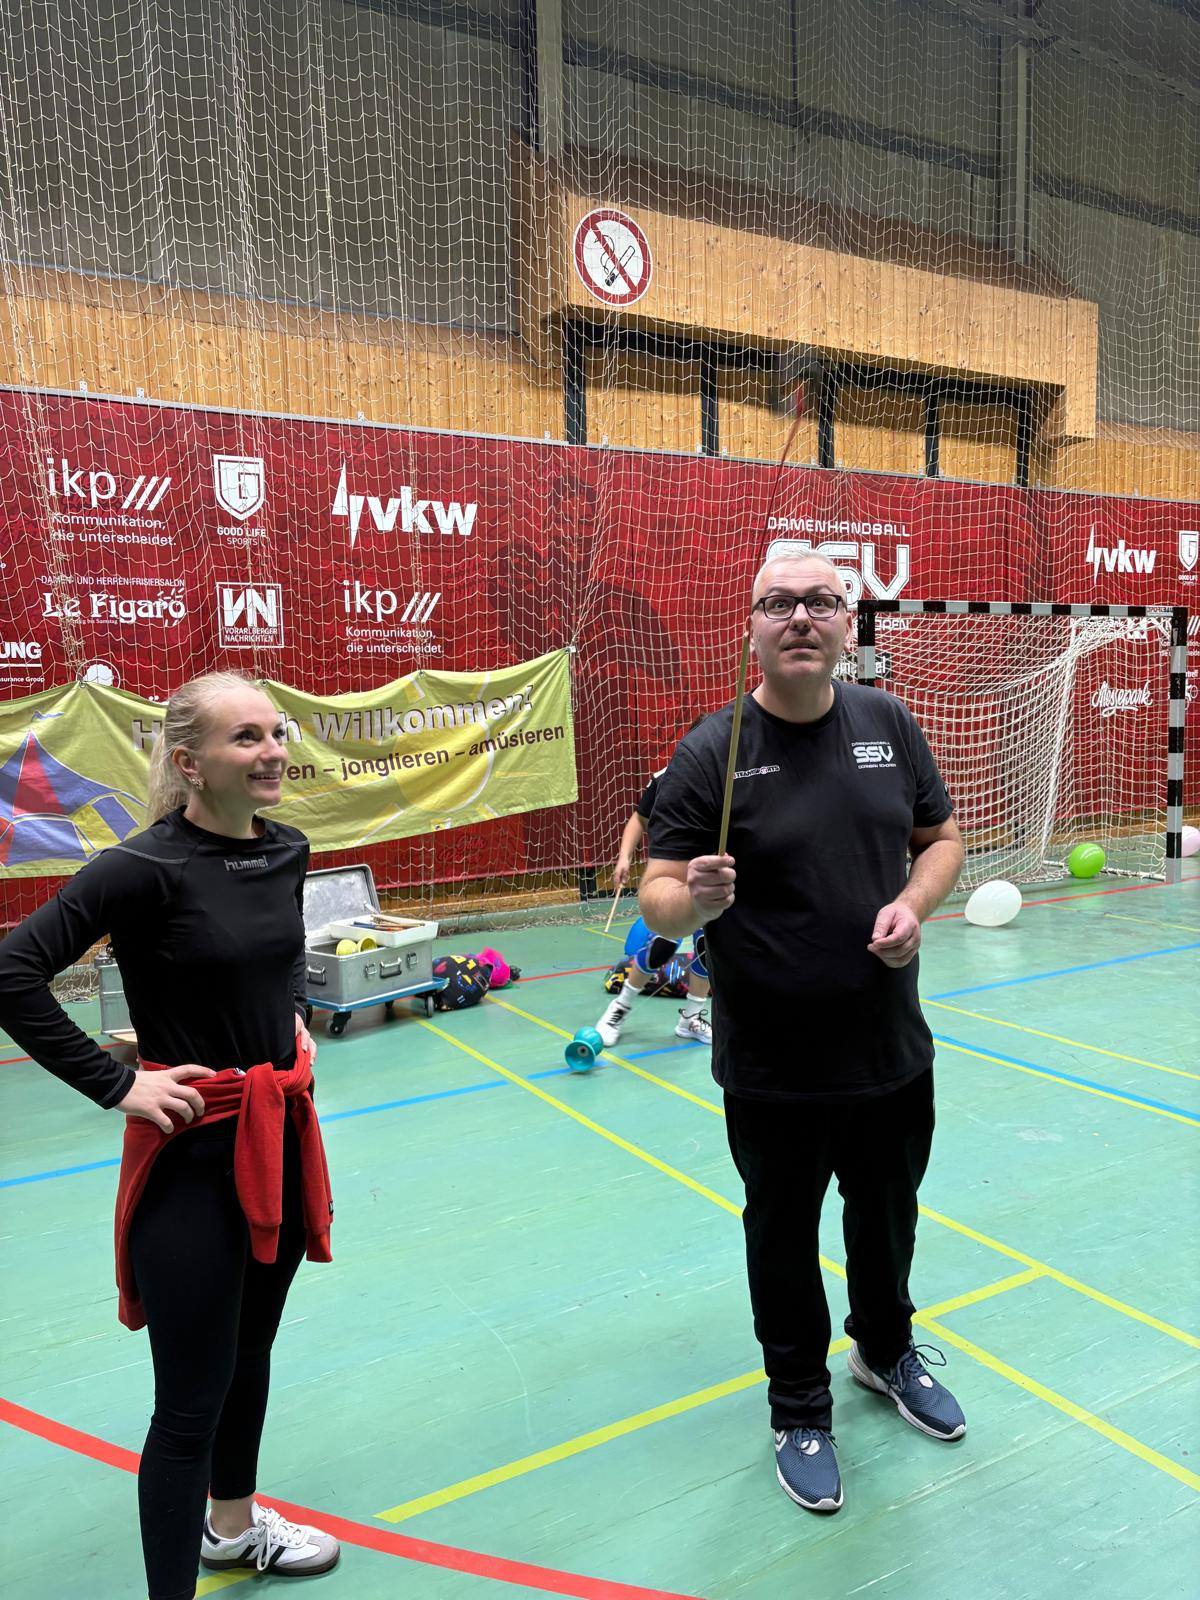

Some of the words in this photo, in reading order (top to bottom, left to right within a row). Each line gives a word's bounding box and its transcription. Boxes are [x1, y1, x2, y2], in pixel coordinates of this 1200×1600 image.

[366, 485, 478, 536] vkw
[217, 526, 244, 536] GOOD
[767, 516, 910, 537] DAMENHANDBALL
[79, 531, 177, 547] unterscheidet.
[1100, 539, 1157, 574] vkw
[77, 576, 95, 586] UND
[42, 592, 82, 618] Le
[342, 580, 398, 622] ikp
[345, 626, 437, 640] Kommunikation,
[346, 642, 364, 654] die
[366, 642, 445, 654] unterscheidet.
[312, 685, 535, 744] Willkommen!
[341, 749, 450, 780] jonglieren
[468, 725, 565, 756] amüsieren
[853, 745, 894, 764] SSV
[223, 854, 269, 872] hummel
